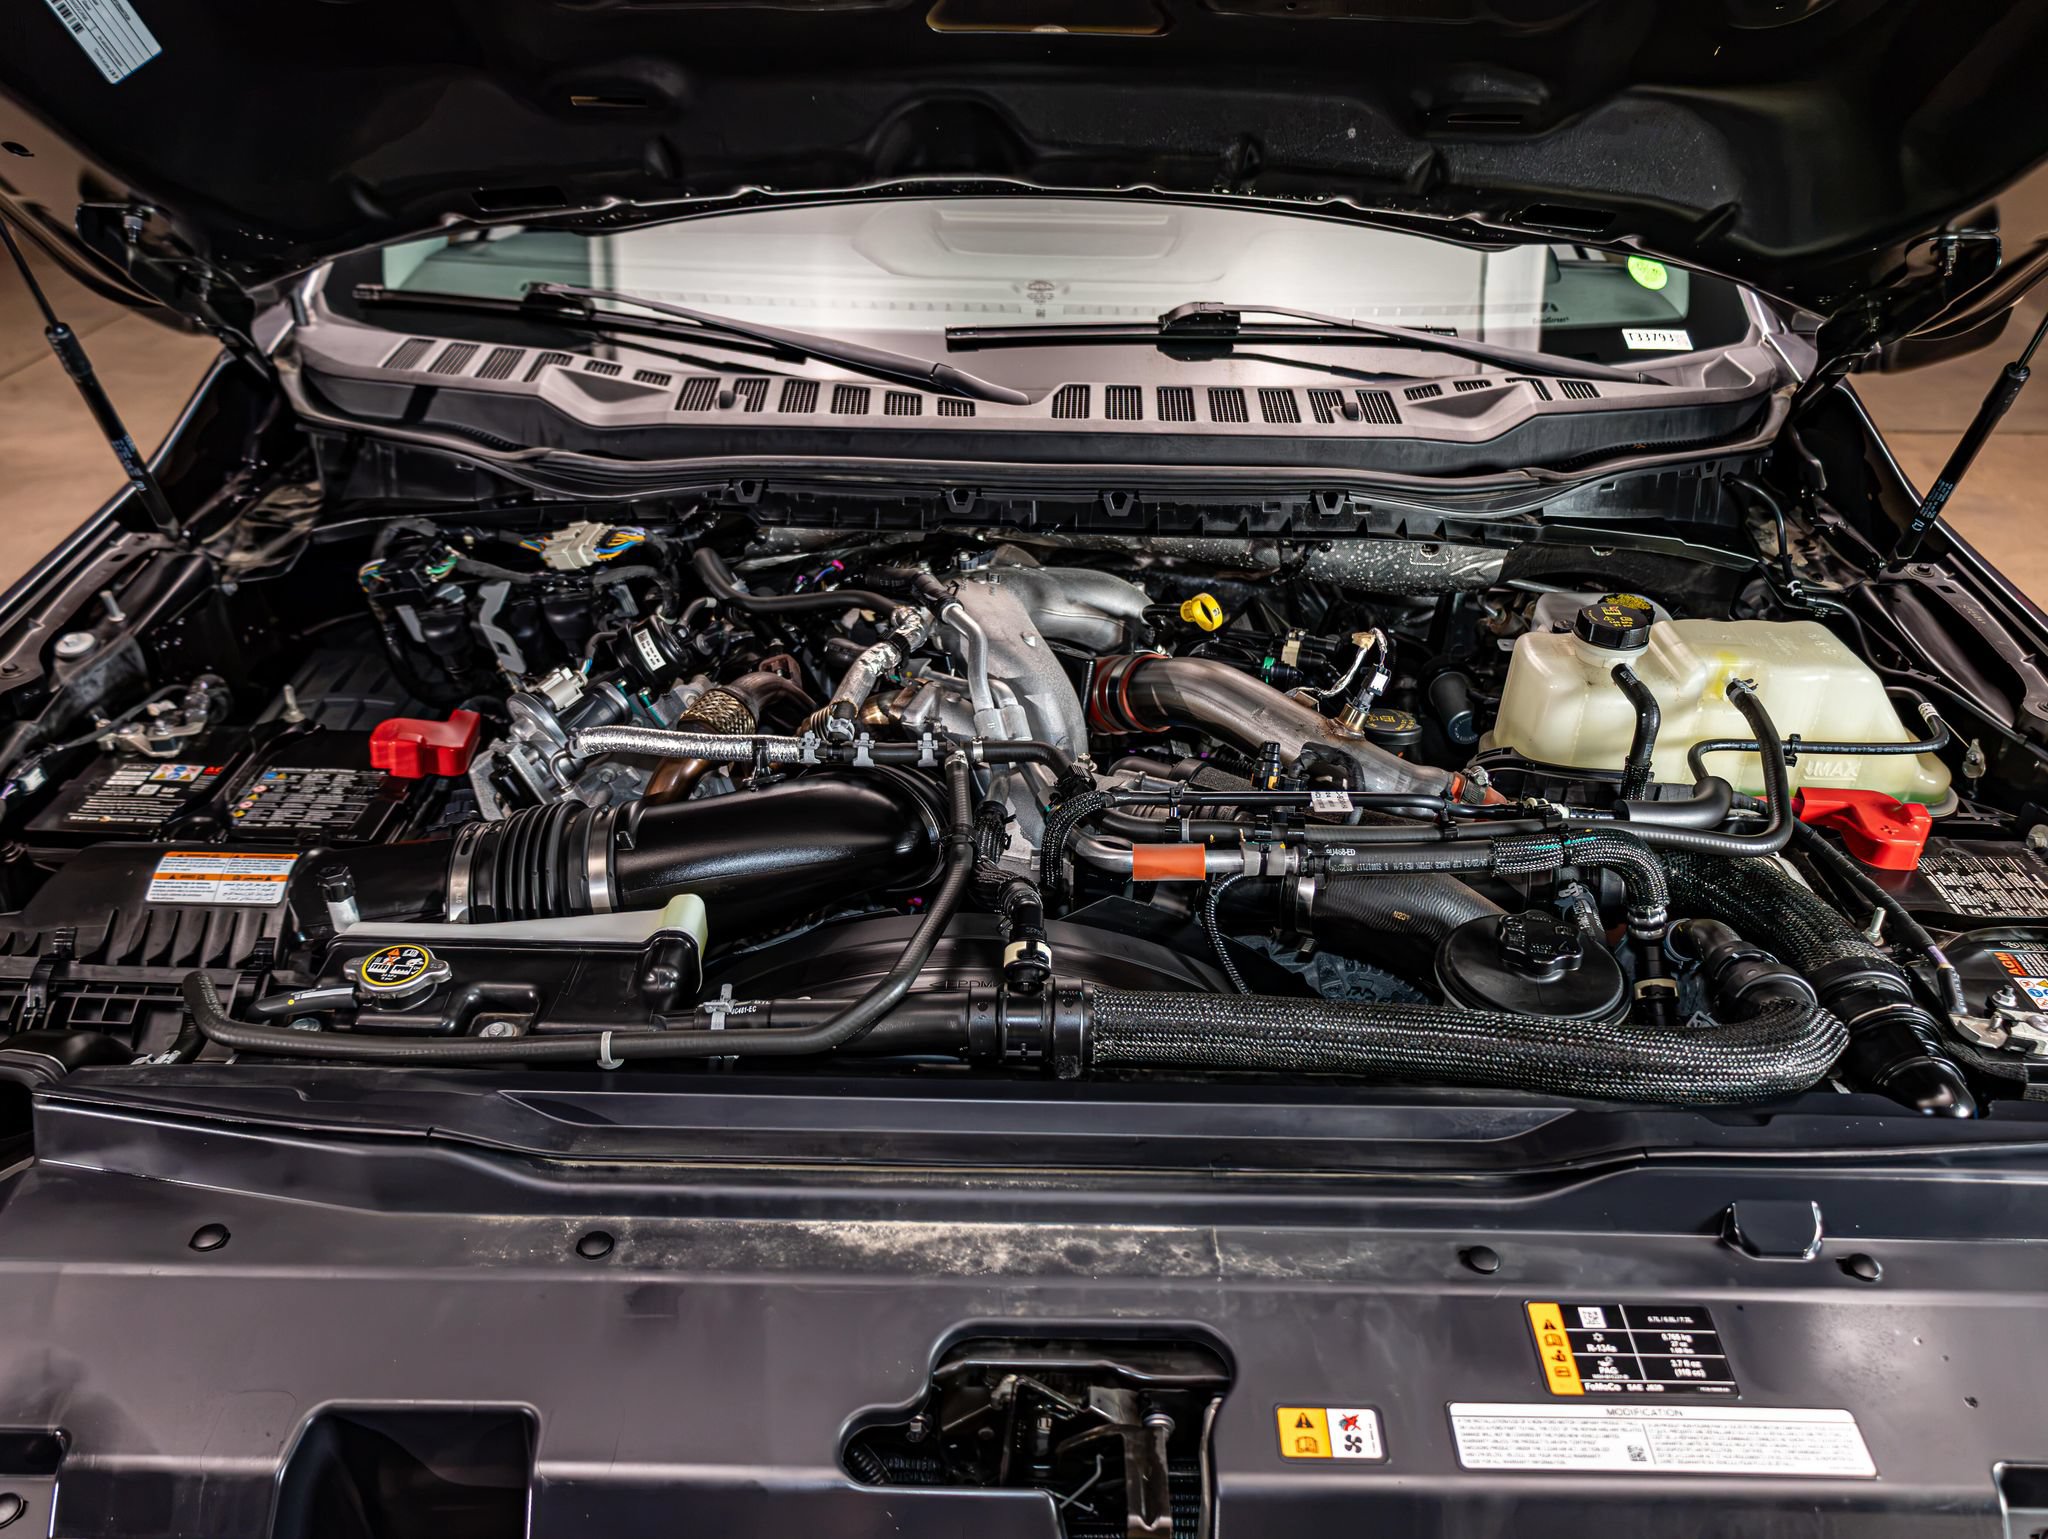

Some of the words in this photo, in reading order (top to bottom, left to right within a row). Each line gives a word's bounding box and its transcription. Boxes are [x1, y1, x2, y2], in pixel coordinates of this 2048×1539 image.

[1586, 1344, 1618, 1352] R-134a
[1598, 1366, 1619, 1374] PAG
[1584, 1382, 1622, 1392] FoMoCo
[1605, 1408, 1684, 1417] MODIFICATION
